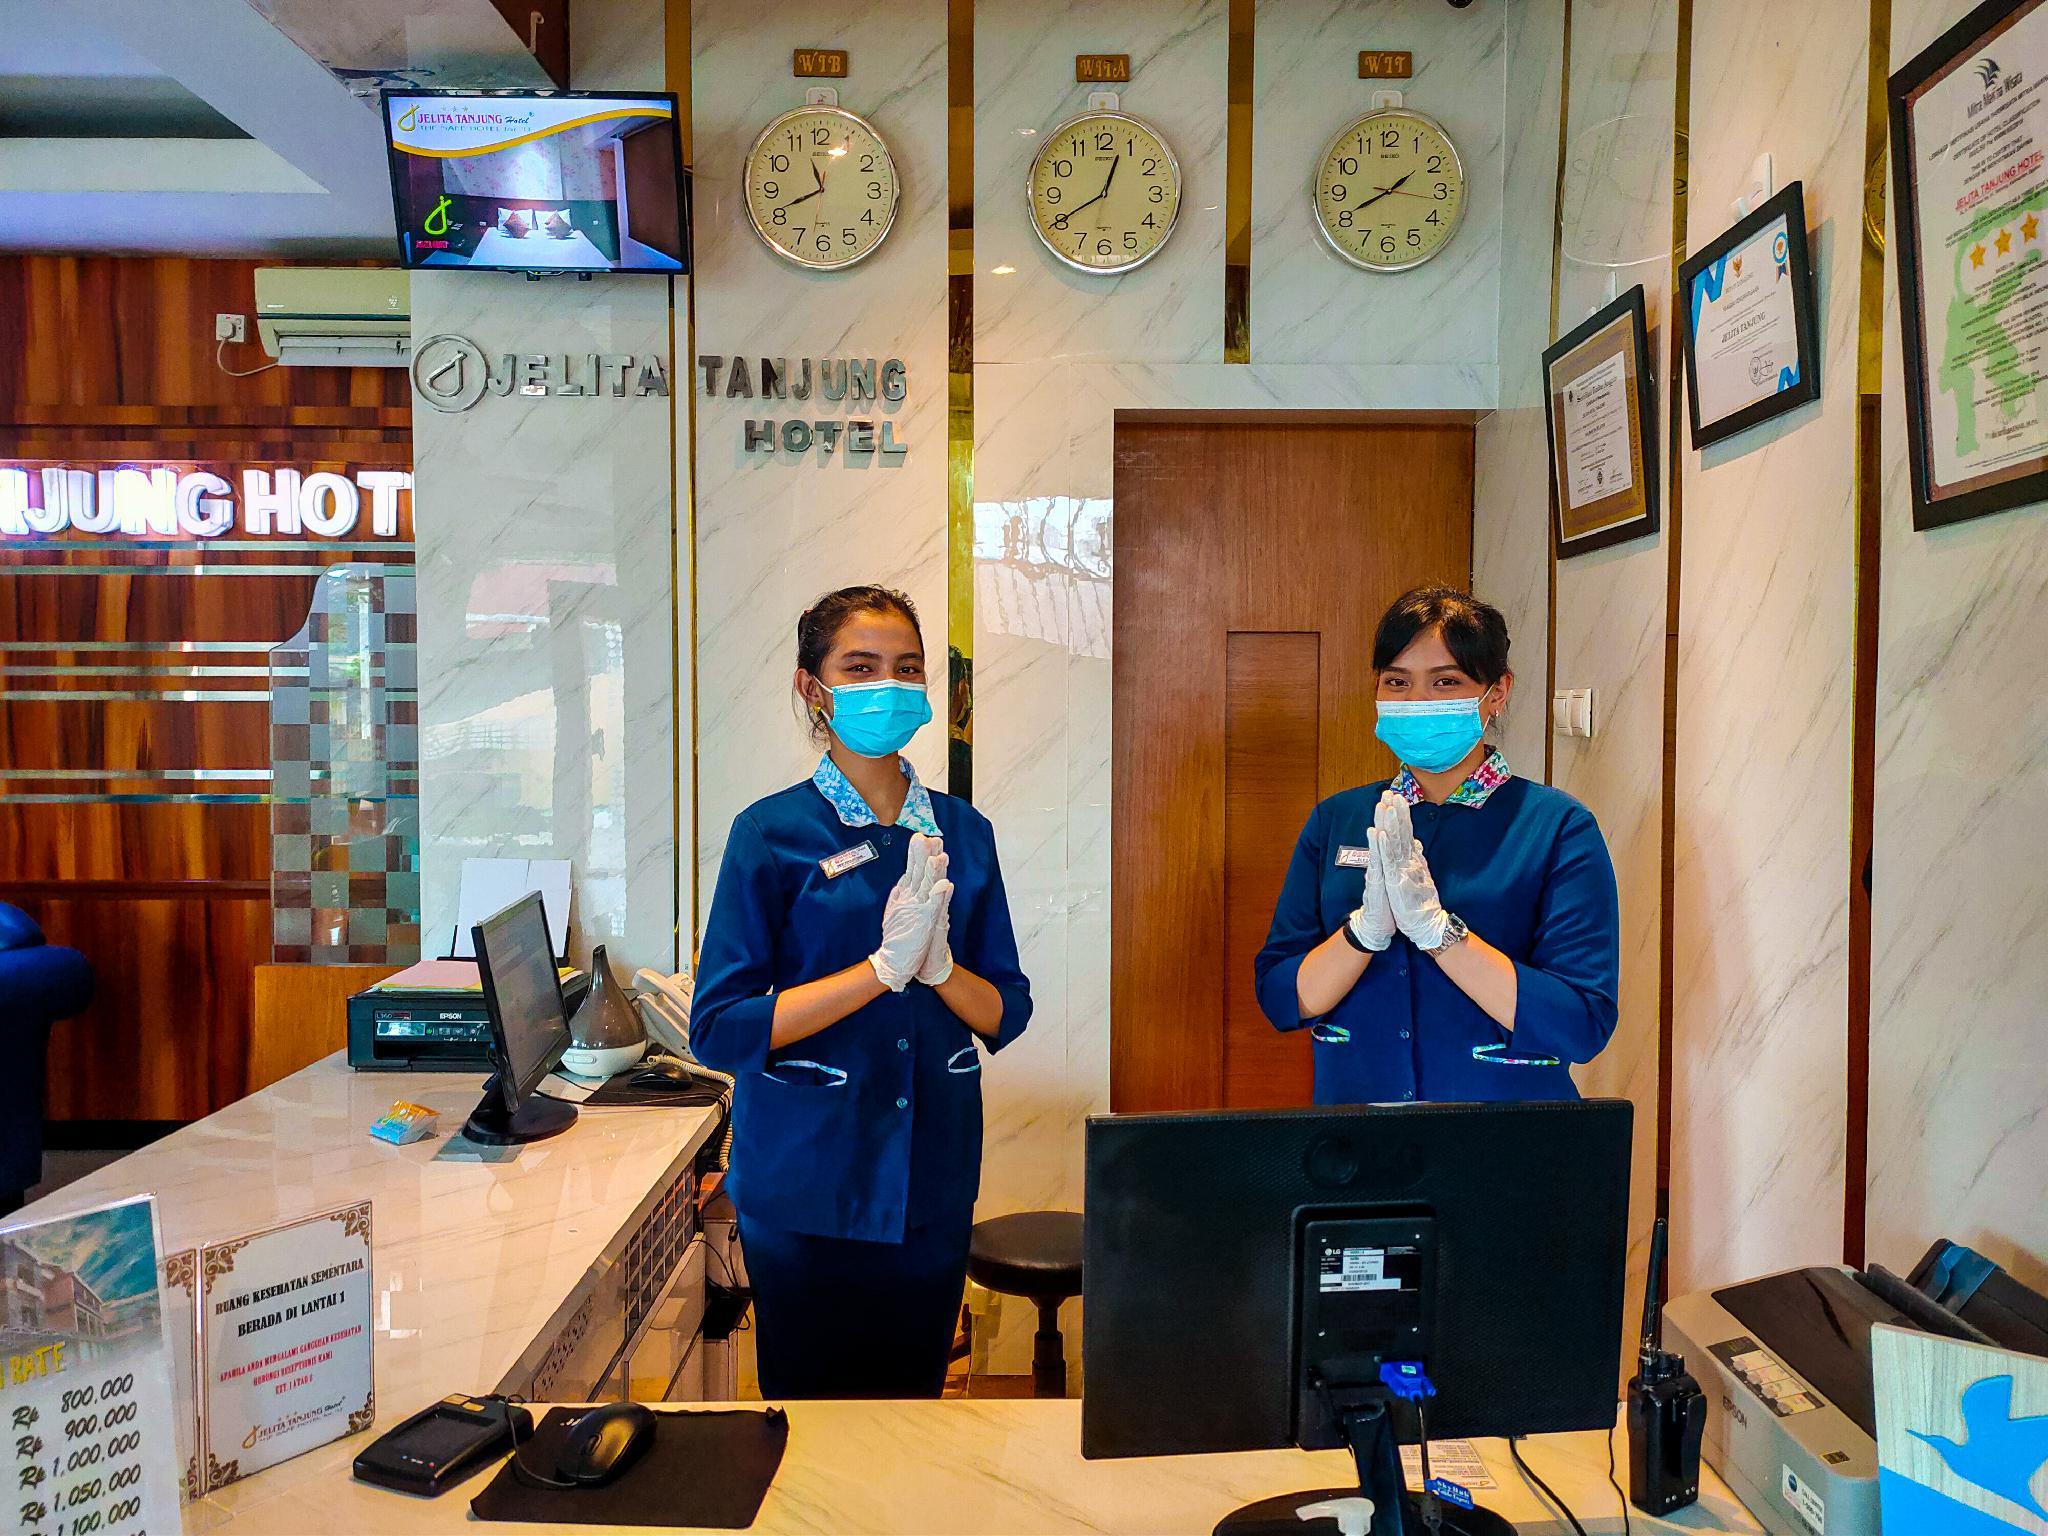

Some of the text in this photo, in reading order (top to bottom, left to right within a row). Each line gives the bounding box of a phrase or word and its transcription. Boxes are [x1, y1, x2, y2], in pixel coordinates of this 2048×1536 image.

[798, 51, 840, 72] WIB
[1365, 52, 1406, 73] WIT
[456, 114, 502, 124] TANJUNG
[787, 134, 802, 152] 11
[811, 129, 830, 145] 12
[1094, 133, 1113, 151] 12
[1357, 137, 1371, 154] 11
[1380, 131, 1399, 148] 12
[1413, 136, 1418, 153] 1
[1071, 139, 1085, 157] 11
[1126, 139, 1133, 157] 1
[769, 155, 790, 172] 10
[860, 155, 874, 172] 2
[1051, 160, 1073, 178] 10
[1142, 159, 1156, 176] 2
[1337, 157, 1358, 175] 10
[1427, 155, 1441, 173] 2
[1981, 166, 2016, 194] TANJUNG
[763, 182, 779, 198] 9
[867, 182, 882, 199] 3
[1047, 187, 1062, 204] 9
[1149, 186, 1162, 203] 3
[1331, 184, 1347, 201] 9
[1434, 183, 1448, 200] 3
[773, 208, 787, 225] 8
[860, 209, 874, 226] 4
[1054, 213, 1069, 230] 8
[1141, 212, 1156, 229] 4
[1339, 210, 1353, 227] 8
[1425, 209, 1439, 226] 4
[792, 228, 806, 245] 7
[816, 235, 831, 252] 6
[842, 229, 857, 245] 5
[1074, 232, 1087, 249] 7
[1123, 232, 1137, 249] 5
[1357, 229, 1371, 247] 7
[1380, 236, 1395, 253] 6
[1407, 229, 1420, 246] 5
[1097, 239, 1112, 256] 6
[486, 354, 908, 401] JELITA TANJUNG
[745, 418, 908, 453] HOTEL
[243, 469, 415, 536] HOT
[216, 1258, 364, 1315] RUANG KESEHATAN SEMENTARA
[238, 1291, 345, 1337] BERADA DI LANTAI 1
[9, 1340, 66, 1385] RATE
